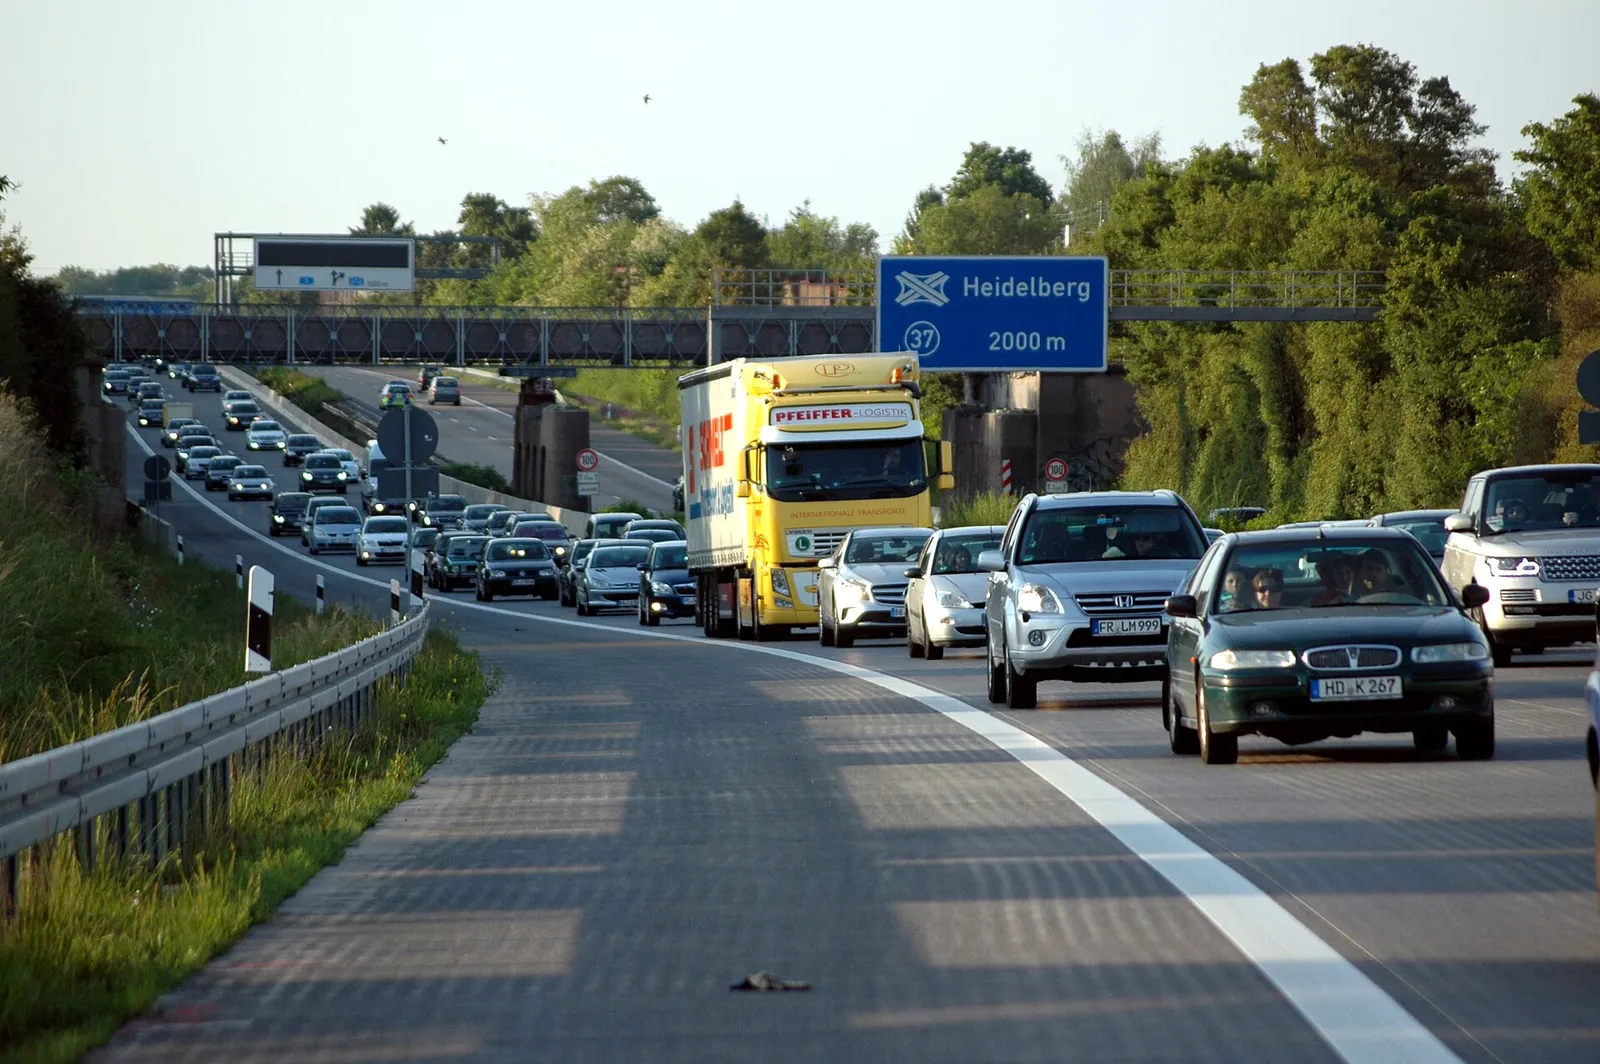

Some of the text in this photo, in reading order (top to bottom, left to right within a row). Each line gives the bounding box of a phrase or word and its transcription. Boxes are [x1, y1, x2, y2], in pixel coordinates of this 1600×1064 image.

[963, 276, 1091, 302] Heidelberg
[910, 329, 935, 349] 37
[989, 331, 1066, 351] 2000 m
[582, 455, 594, 465] 100
[1050, 464, 1064, 475] 100
[790, 507, 906, 519] INTERNATIONALE TRANSPORTE
[1099, 620, 1159, 633] FR LM 999
[1325, 678, 1396, 695] HD K 267
